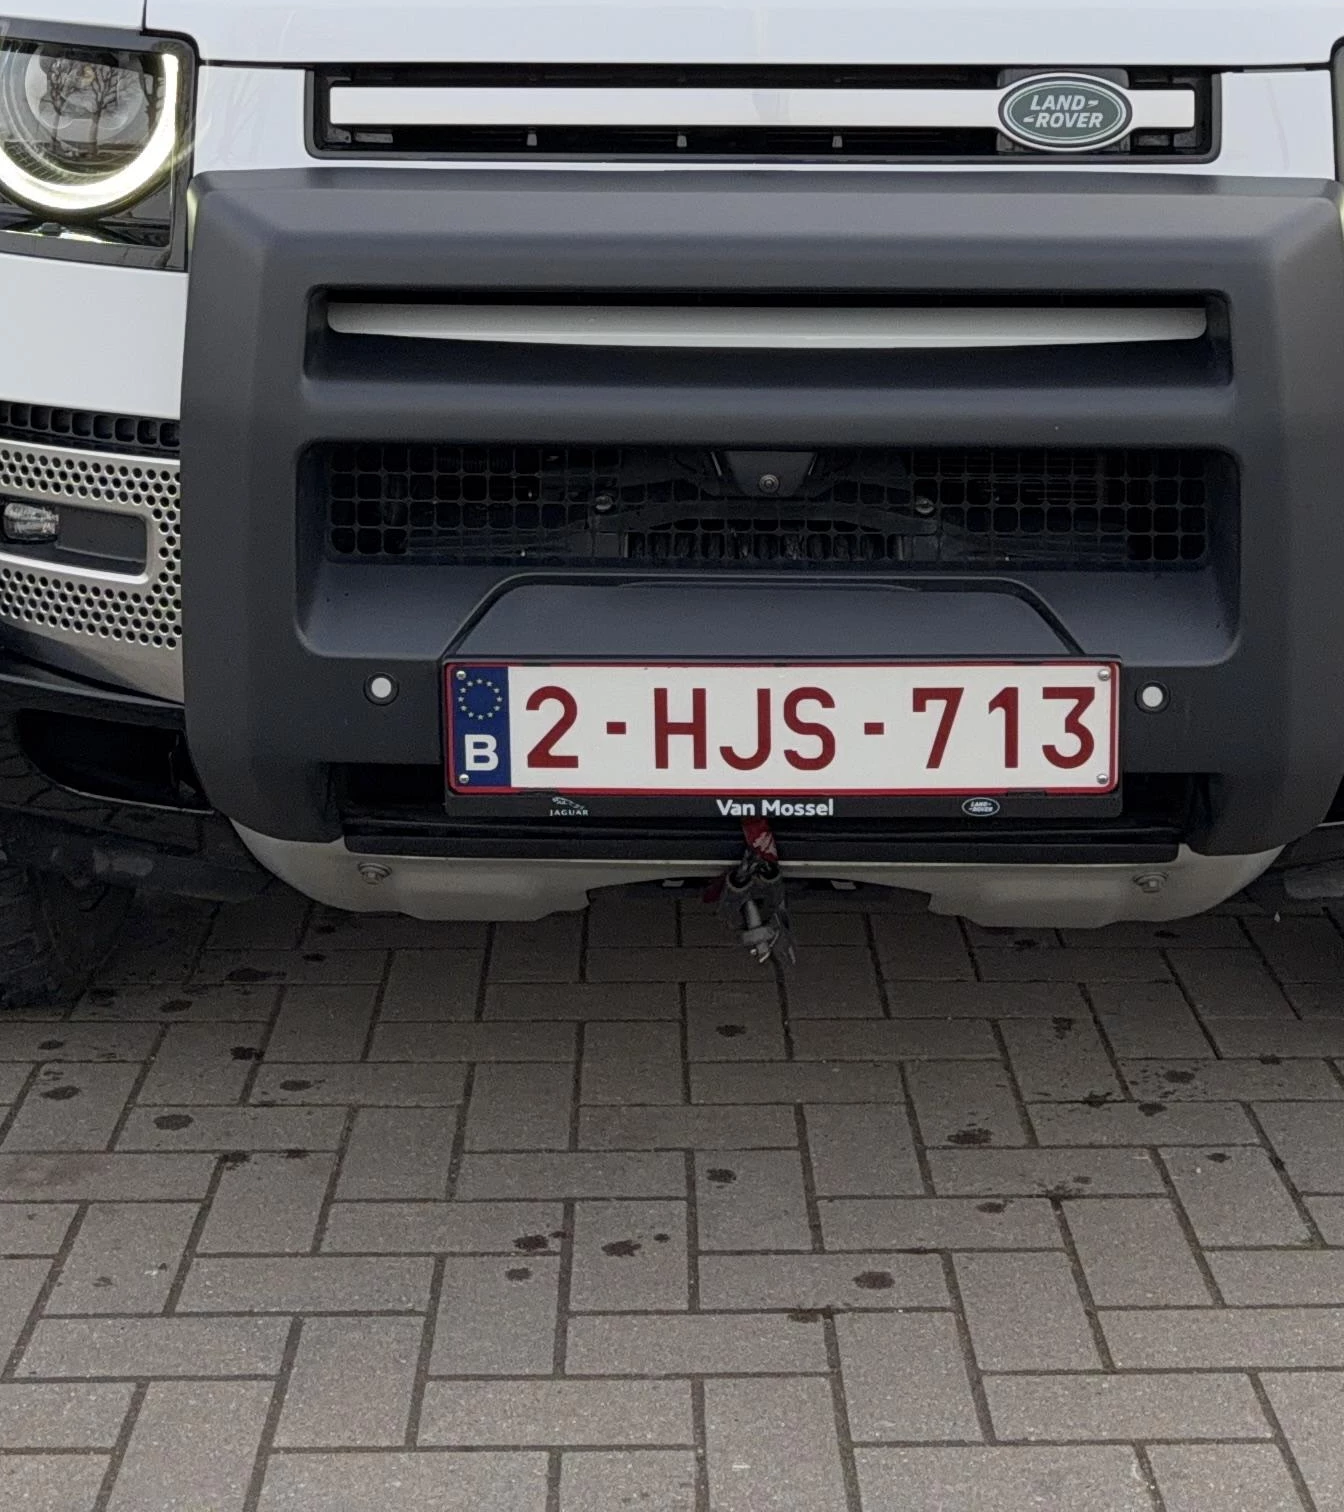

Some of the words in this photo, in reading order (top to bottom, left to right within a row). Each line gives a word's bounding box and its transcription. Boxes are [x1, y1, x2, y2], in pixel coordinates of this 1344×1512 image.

[524, 685, 1097, 772] 2-HJS-713
[464, 734, 500, 772] B
[549, 809, 589, 817] JAGUAR
[716, 799, 756, 817] Van
[761, 798, 835, 817] Mossel
